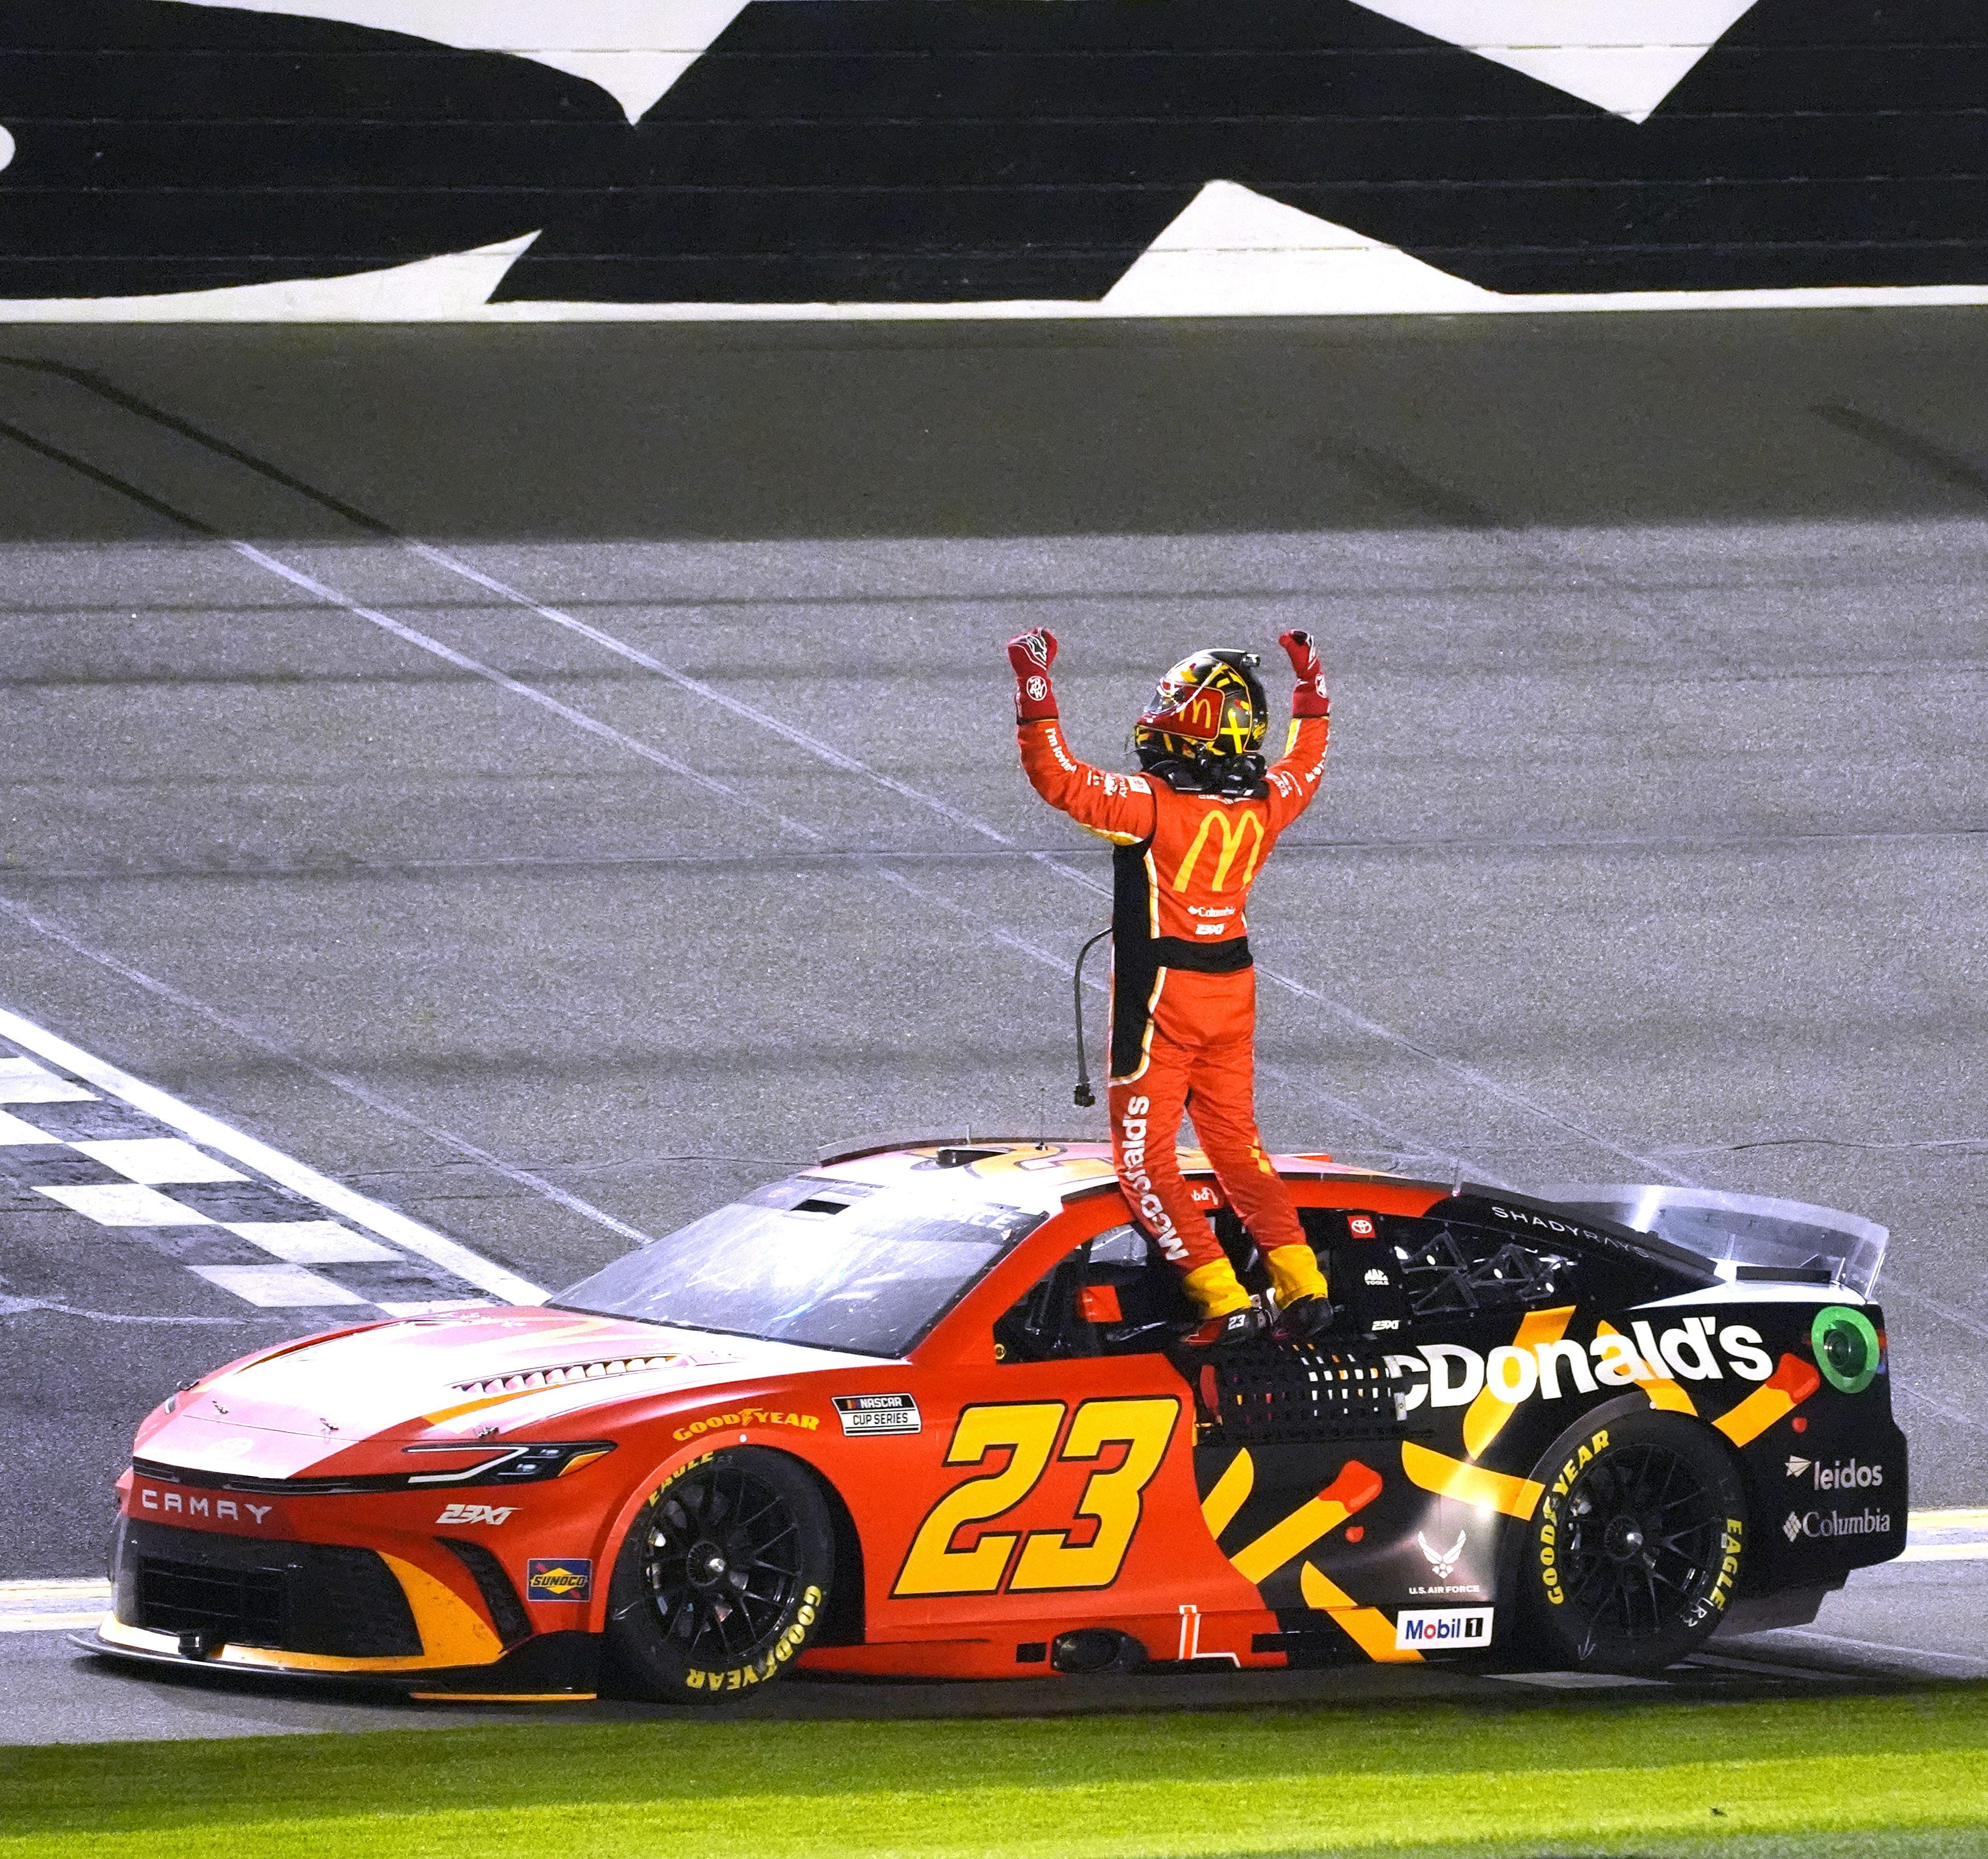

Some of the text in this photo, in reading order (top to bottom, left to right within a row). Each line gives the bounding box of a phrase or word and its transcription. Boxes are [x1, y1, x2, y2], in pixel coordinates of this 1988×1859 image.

[1227, 1314, 1246, 1331] 23
[1382, 1316, 1773, 1412] cDonald's
[853, 1412, 908, 1425] CUP SERIES
[859, 1396, 903, 1409] NASCAR
[673, 1407, 820, 1441] GOODYEAR
[1813, 1457, 1883, 1491] leidos
[888, 1394, 1182, 1600] 23
[1540, 1429, 1610, 1604] GOODYEAR
[1802, 1508, 1891, 1538] Columbia
[1710, 1518, 1742, 1611] EAGLE
[532, 1576, 586, 1586] SUNOCO
[1409, 1586, 1427, 1595] U.S.
[686, 1585, 822, 1691] GOODYEAR
[1405, 1618, 1461, 1640] Mobil
